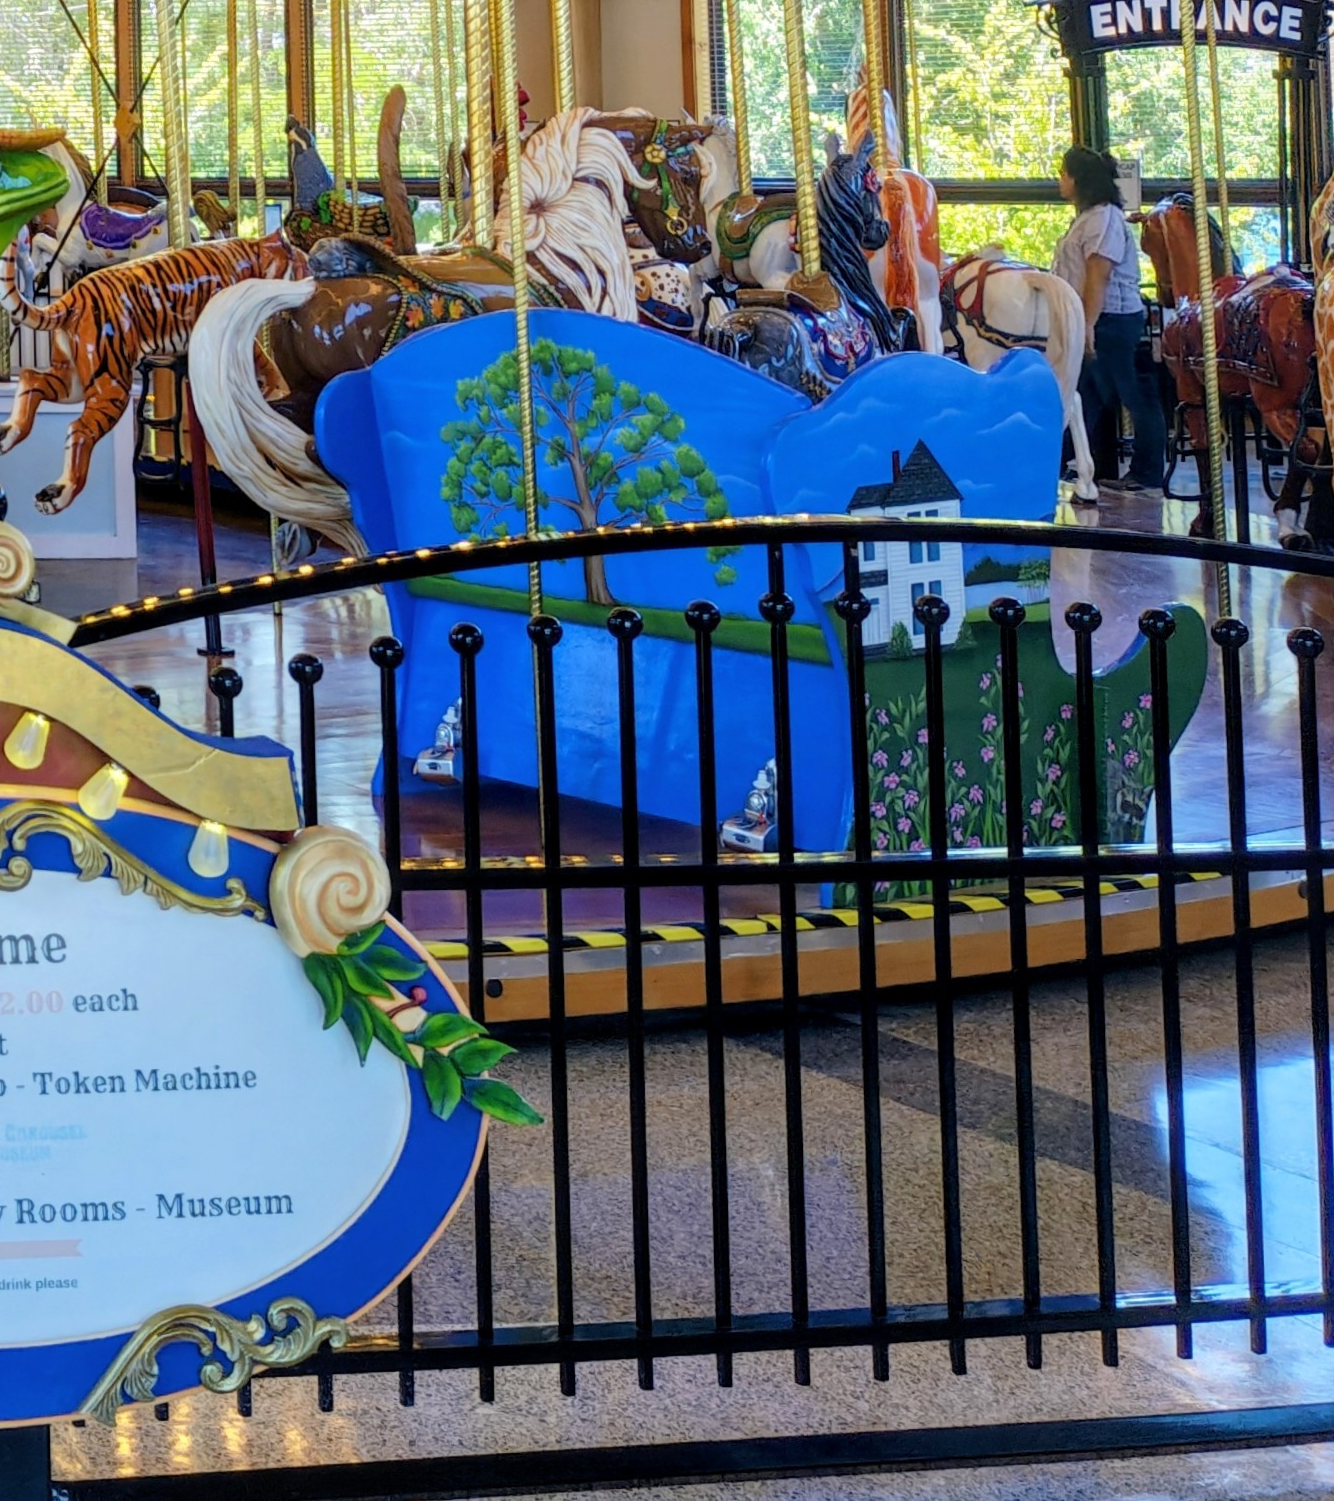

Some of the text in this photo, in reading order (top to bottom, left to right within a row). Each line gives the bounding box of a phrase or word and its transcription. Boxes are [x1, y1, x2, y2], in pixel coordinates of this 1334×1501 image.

[72, 988, 140, 1013] each
[32, 1070, 127, 1096] Token
[134, 1065, 257, 1093] Machine
[15, 1198, 127, 1225] Rooms
[155, 1193, 294, 1219] Museum
[35, 1277, 78, 1292] please
